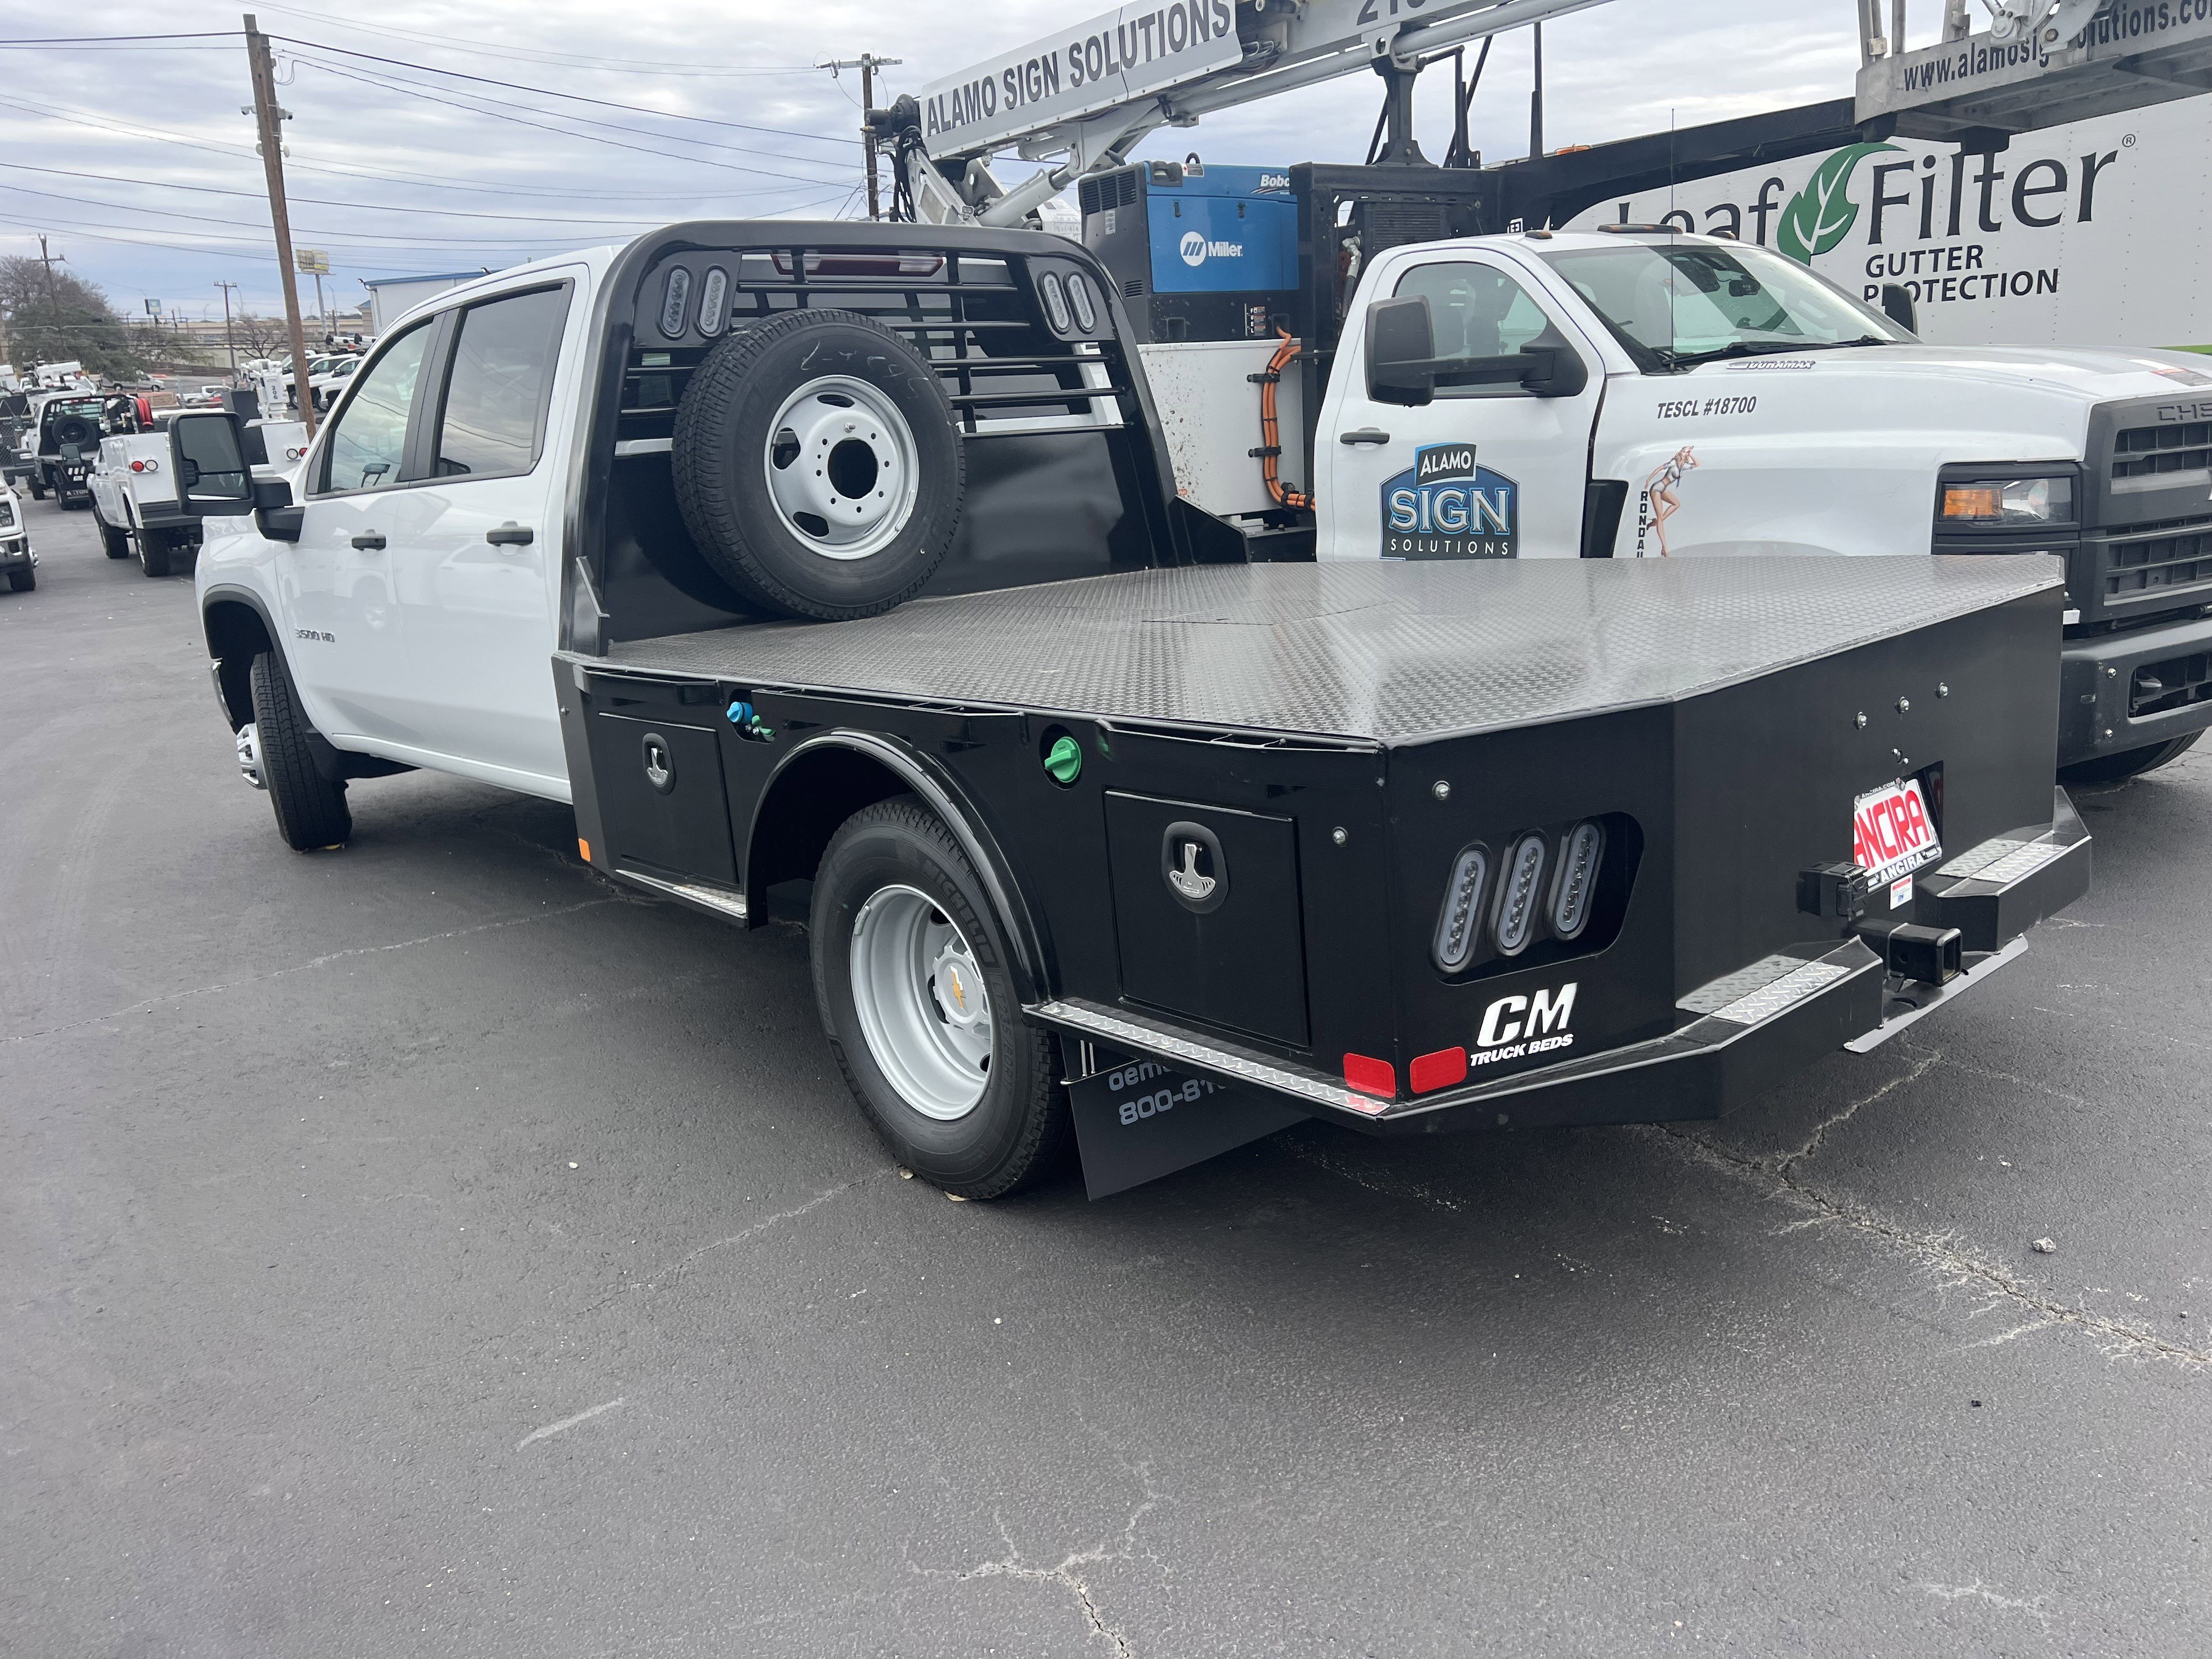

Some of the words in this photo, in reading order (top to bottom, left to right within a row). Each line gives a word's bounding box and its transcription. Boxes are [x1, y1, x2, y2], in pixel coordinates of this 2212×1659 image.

[927, 75, 996, 137] ALAMO
[1003, 50, 1060, 110] SIGN
[1069, 0, 1231, 88] SOLUTIONS
[1867, 149, 2119, 246] Filter
[1208, 241, 1243, 257] Miller
[1865, 245, 1984, 278] GUTTER
[1864, 268, 2059, 303] POTECTION
[1657, 400, 1699, 419] TESCL
[1703, 396, 1757, 416] #18700
[1420, 451, 1471, 477] ALAMO
[1389, 487, 1510, 535] SIGN
[1390, 538, 1509, 555] SOLUTIONS
[295, 628, 320, 641] 3500
[320, 631, 335, 642] HD
[1854, 790, 1931, 870] ANCIRA
[1881, 852, 1925, 883] ANCIRA
[1476, 981, 1579, 1047] CM
[1470, 1042, 1527, 1066] TRUCK
[1528, 1033, 1574, 1054] BEDS
